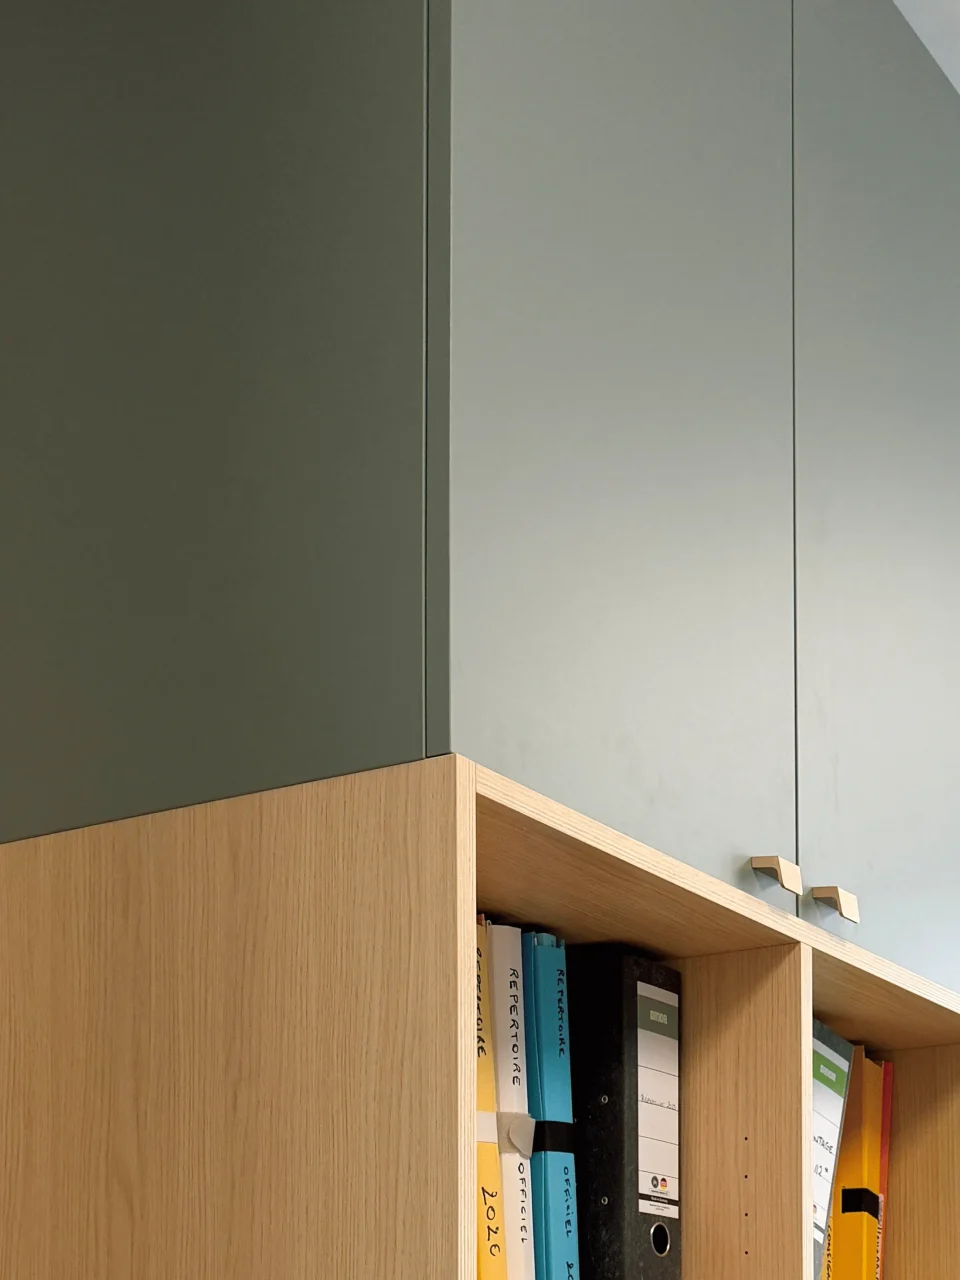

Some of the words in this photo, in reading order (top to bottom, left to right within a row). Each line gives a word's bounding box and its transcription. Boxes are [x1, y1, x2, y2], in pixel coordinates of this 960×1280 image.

[509, 967, 521, 1087] REPERTOIRE
[556, 968, 566, 1059] REPERTOIRE
[517, 1162, 528, 1244] OFFICIEL
